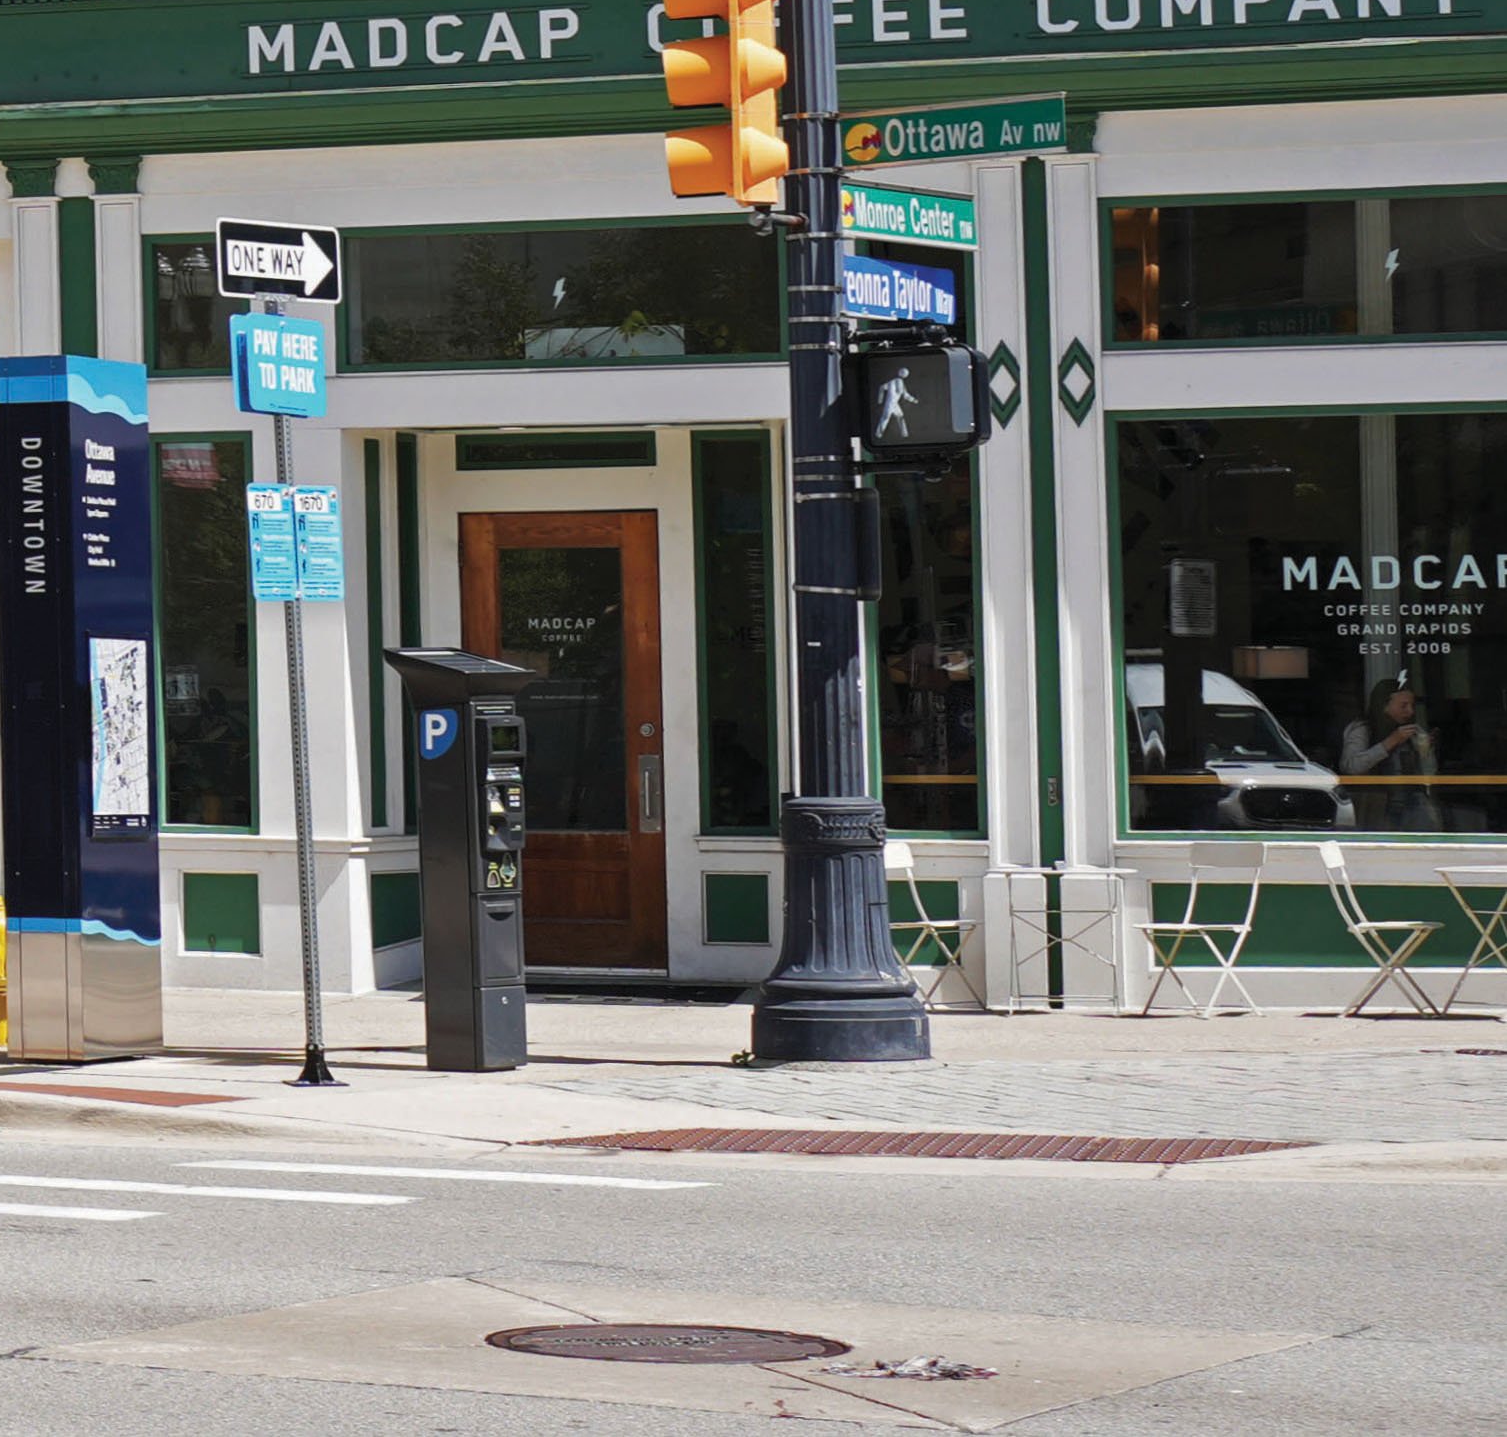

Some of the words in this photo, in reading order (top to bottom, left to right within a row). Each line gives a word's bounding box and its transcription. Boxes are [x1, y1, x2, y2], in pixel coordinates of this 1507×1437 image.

[247, 7, 580, 75] MADCAP
[884, 117, 985, 157] Ottawa
[999, 119, 1024, 147] Av
[1032, 121, 1062, 143] nw
[853, 189, 906, 233] Monroe
[909, 196, 955, 239] Center
[232, 244, 266, 274] ONE
[271, 247, 305, 276] WAY
[843, 270, 890, 308] eonna
[253, 328, 278, 357] PAY
[282, 331, 319, 362] HERE
[258, 362, 277, 390] TO
[280, 364, 317, 395] PARK
[21, 437, 46, 593] DOWNTOWN
[254, 494, 274, 510] 670
[298, 495, 323, 511] 1670
[527, 617, 596, 629] MADCAP
[1323, 604, 1392, 617] COFFEE
[1399, 603, 1485, 616] COMPANY
[1336, 623, 1398, 636] GRAND
[1405, 623, 1473, 635] RAPIDS
[1358, 642, 1399, 655] EST.
[1406, 642, 1452, 655] 2008
